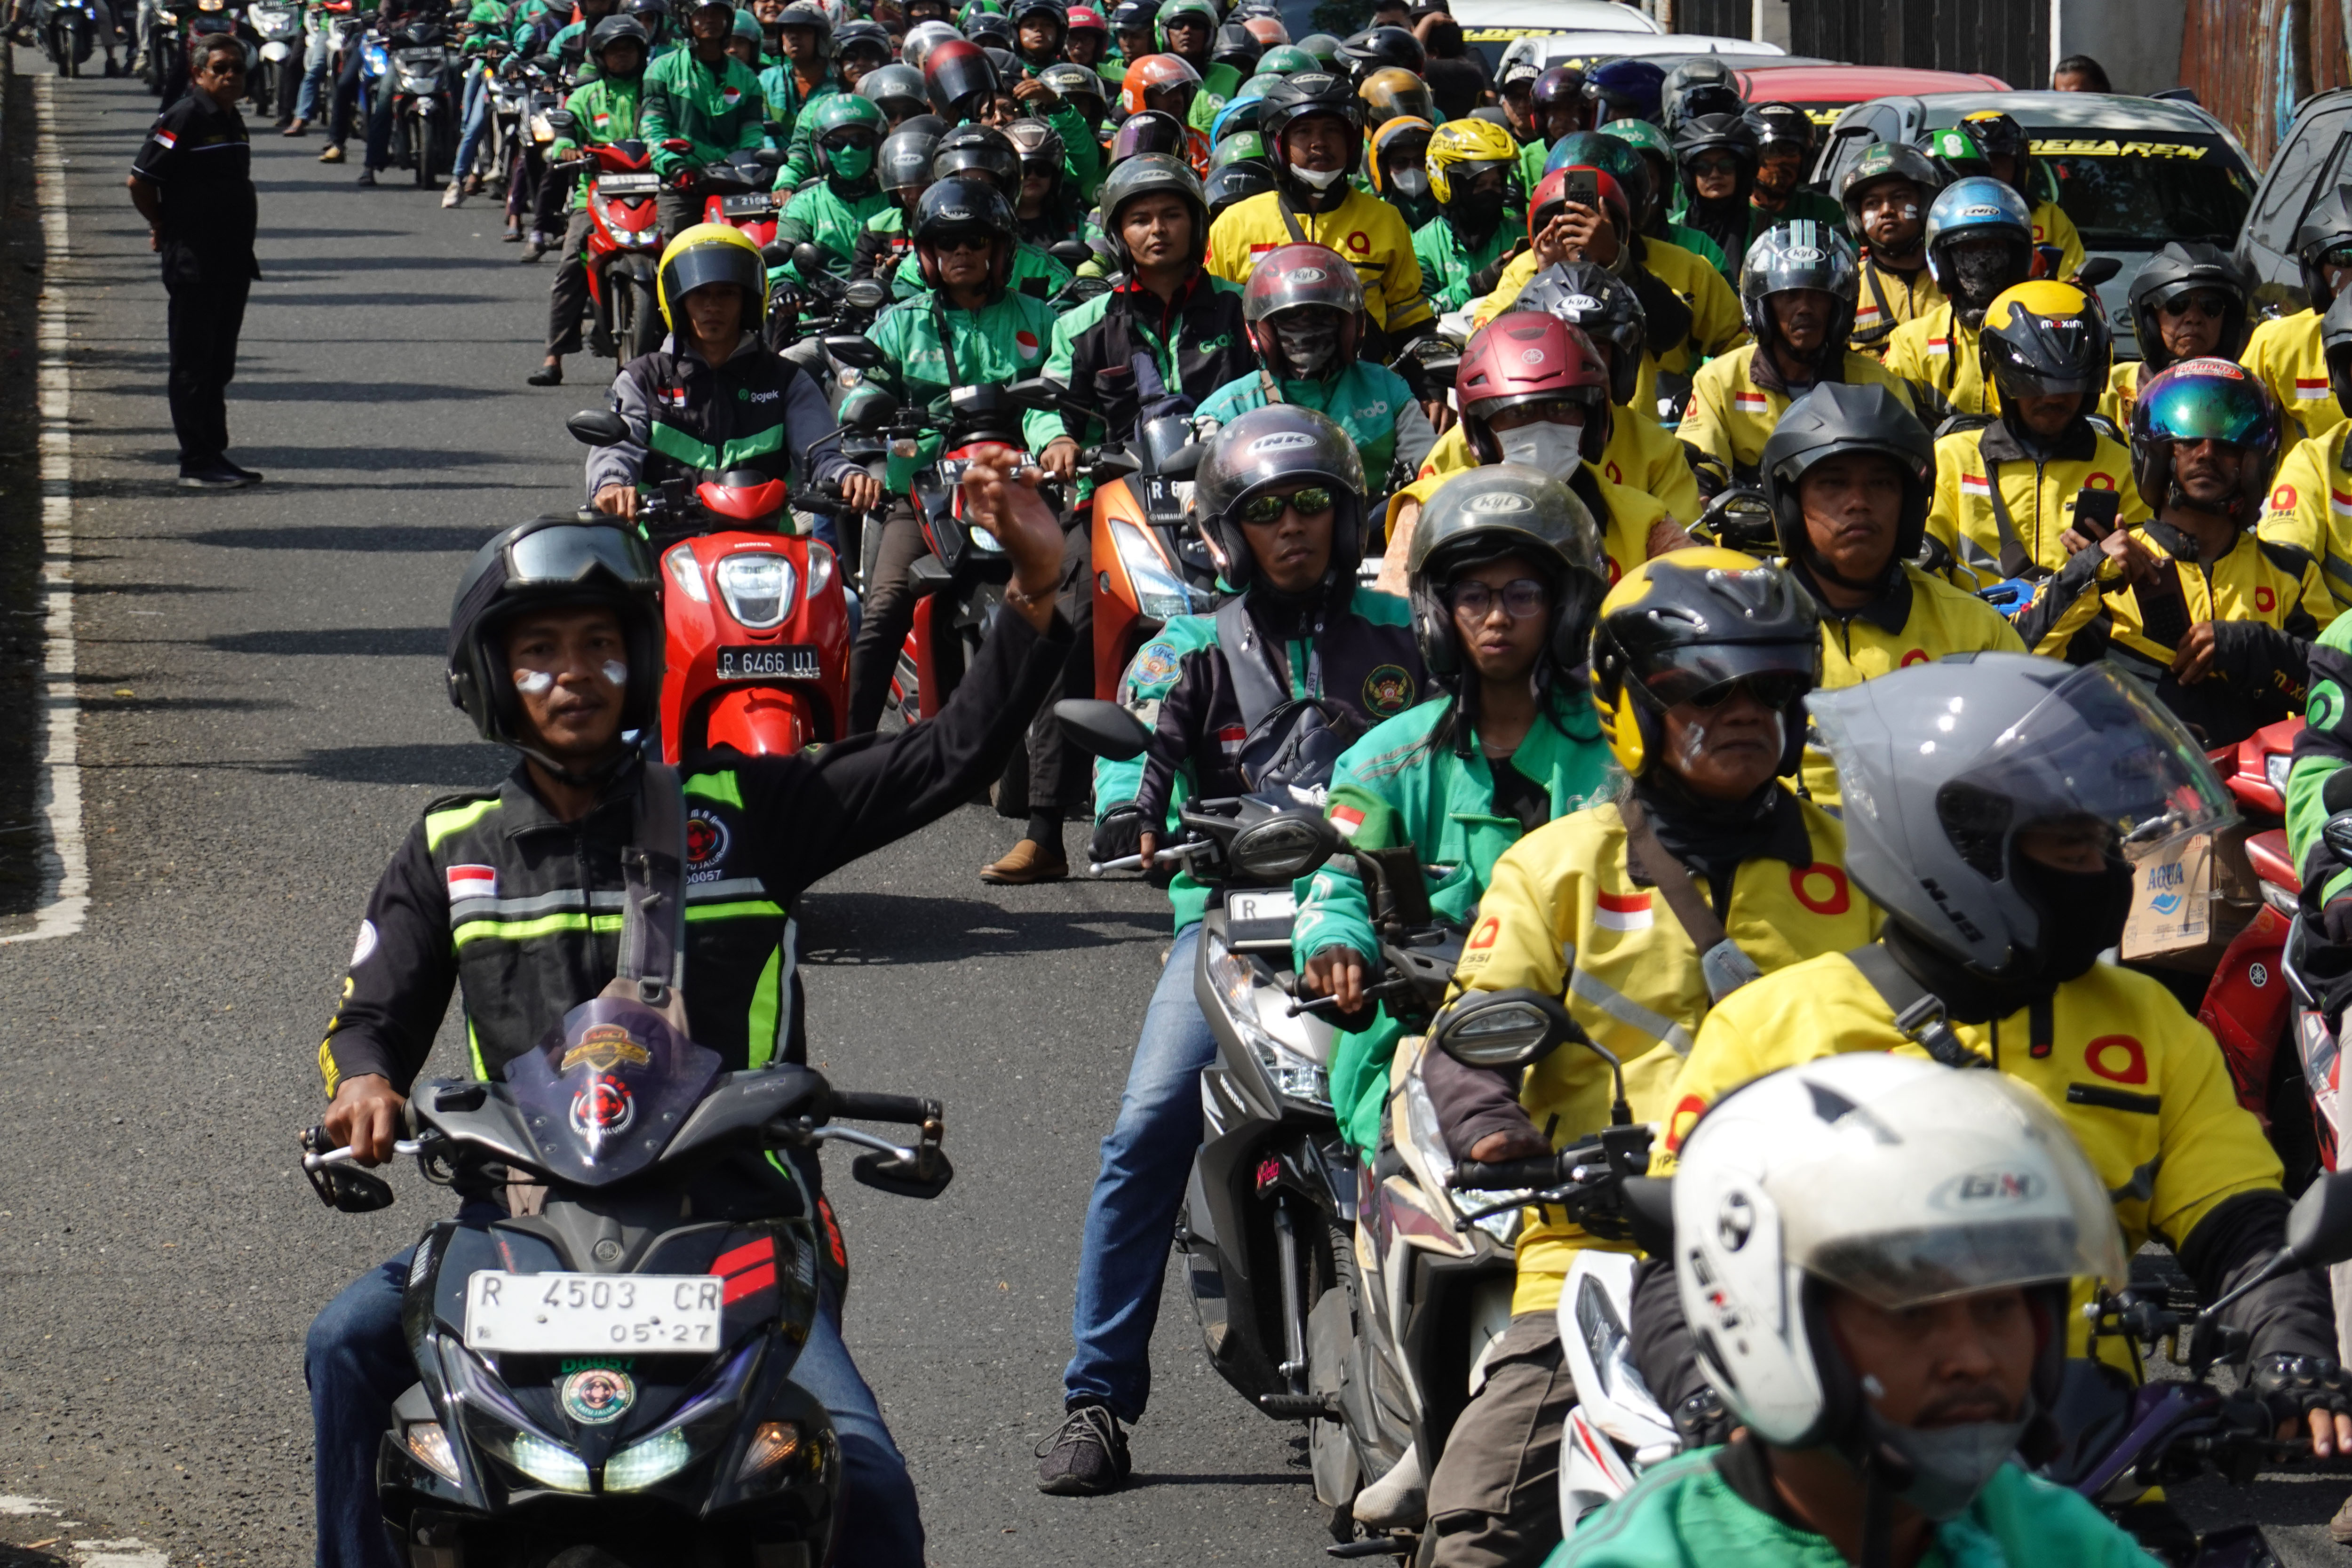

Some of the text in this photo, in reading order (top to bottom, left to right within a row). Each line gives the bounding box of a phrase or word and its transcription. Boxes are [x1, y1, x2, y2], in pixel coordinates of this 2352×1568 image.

[751, 390, 779, 403] gojek
[1152, 482, 1164, 500] R
[723, 653, 733, 673] R
[743, 653, 785, 673] 6466
[1291, 759, 1316, 783] FASHION
[2146, 862, 2185, 891] AQUA
[1242, 899, 1256, 918] R
[1219, 1073, 1246, 1112] HONDA
[482, 1276, 718, 1311] R 4503 CR
